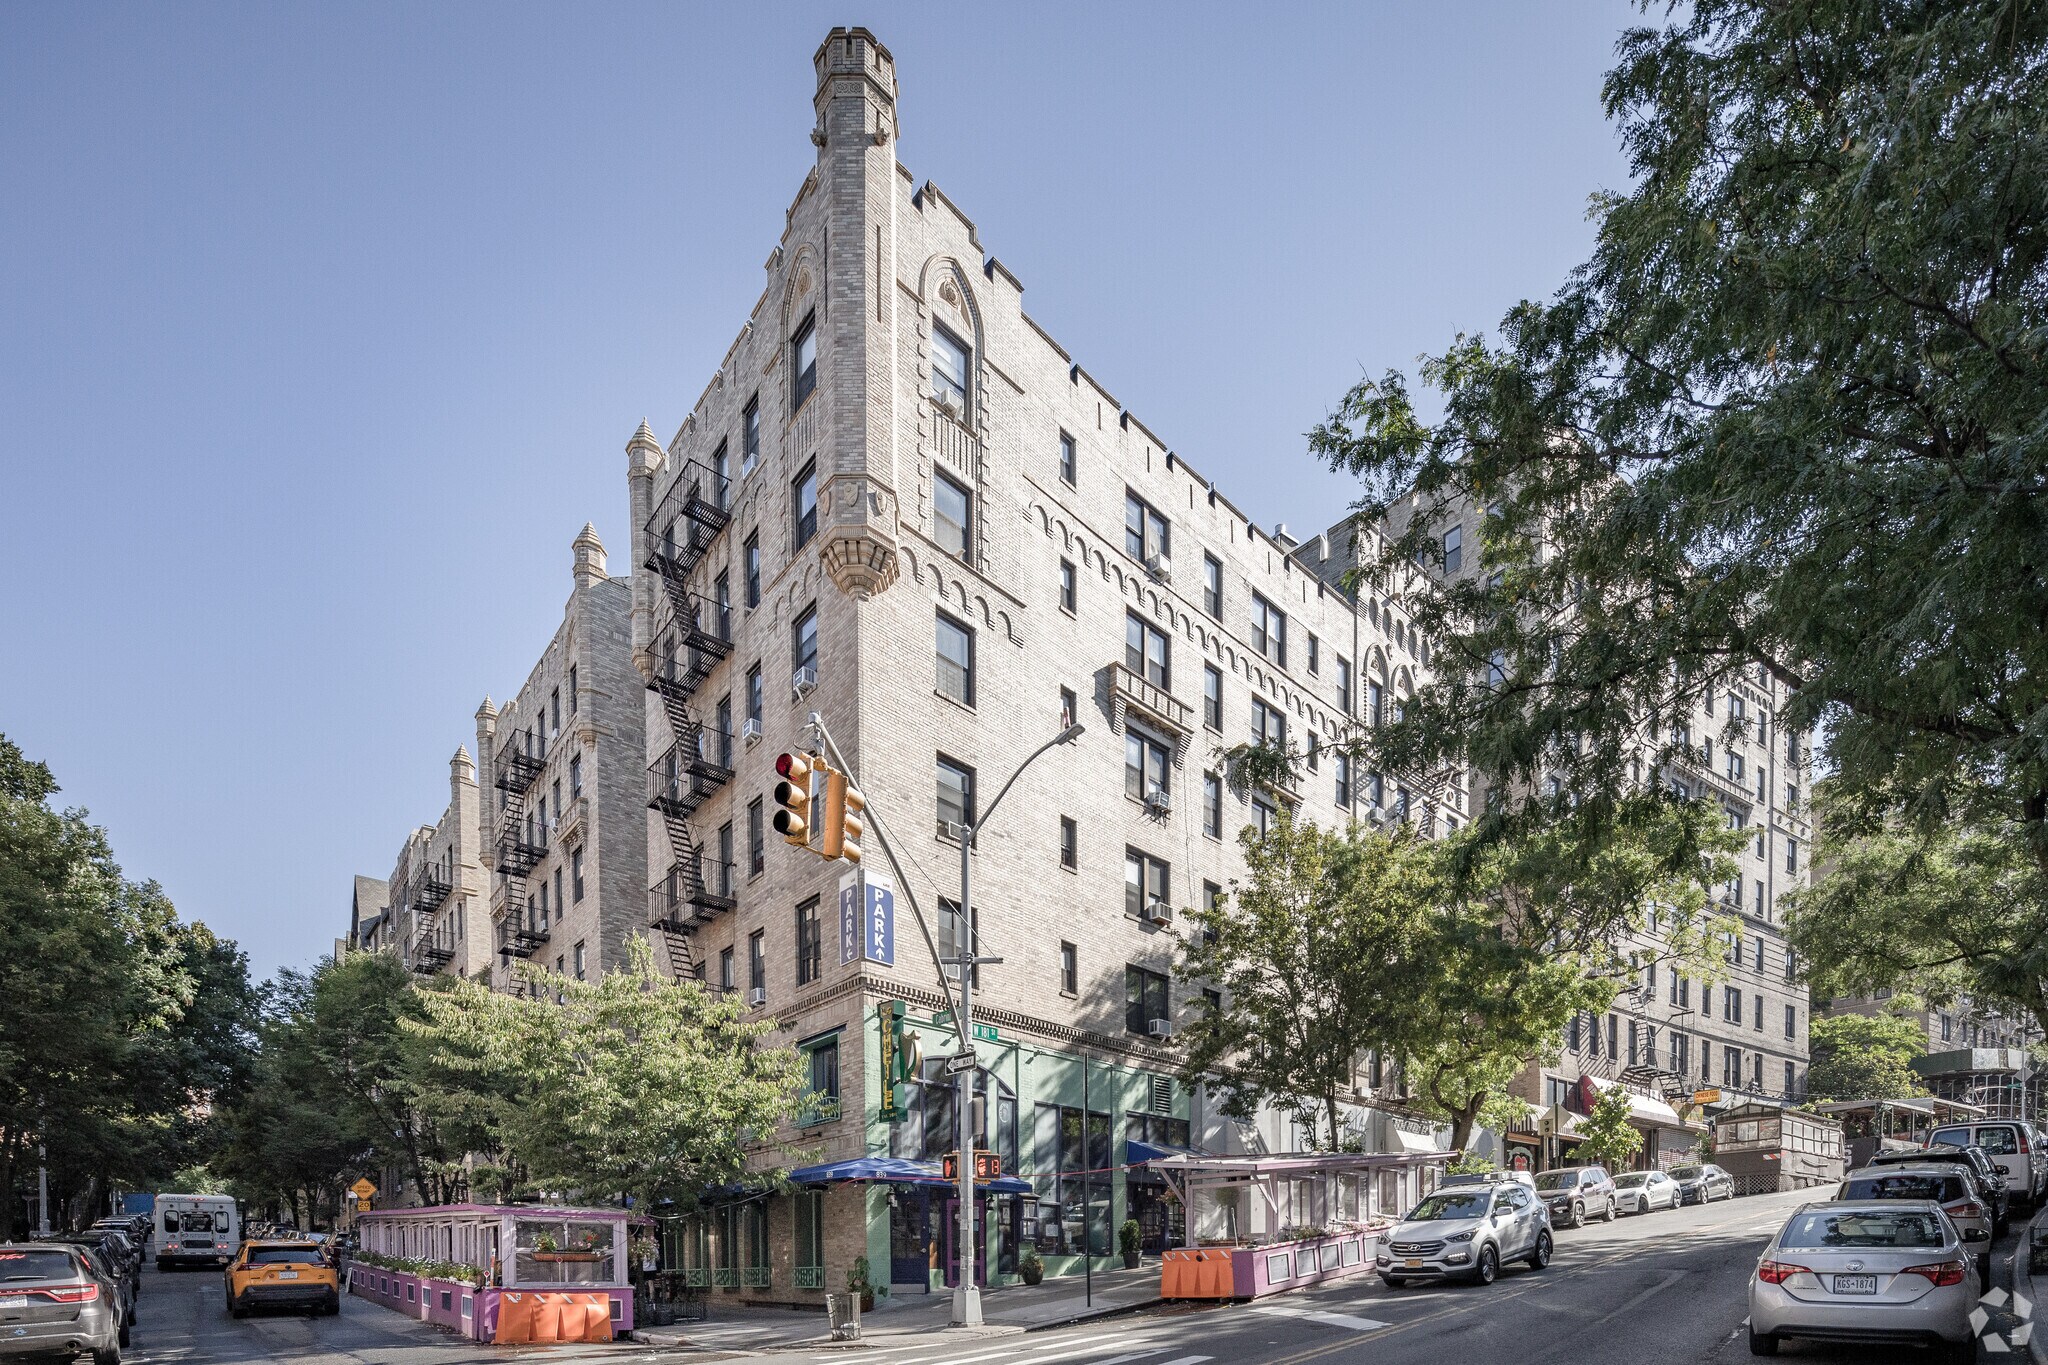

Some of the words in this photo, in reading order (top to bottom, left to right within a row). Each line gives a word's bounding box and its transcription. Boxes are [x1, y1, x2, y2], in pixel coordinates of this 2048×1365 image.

[845, 888, 853, 948] PARK
[873, 887, 885, 948] PARK
[974, 1025, 979, 1035] W
[981, 1026, 990, 1038] 181
[950, 1060, 959, 1069] ONE
[992, 1160, 999, 1174] 13
